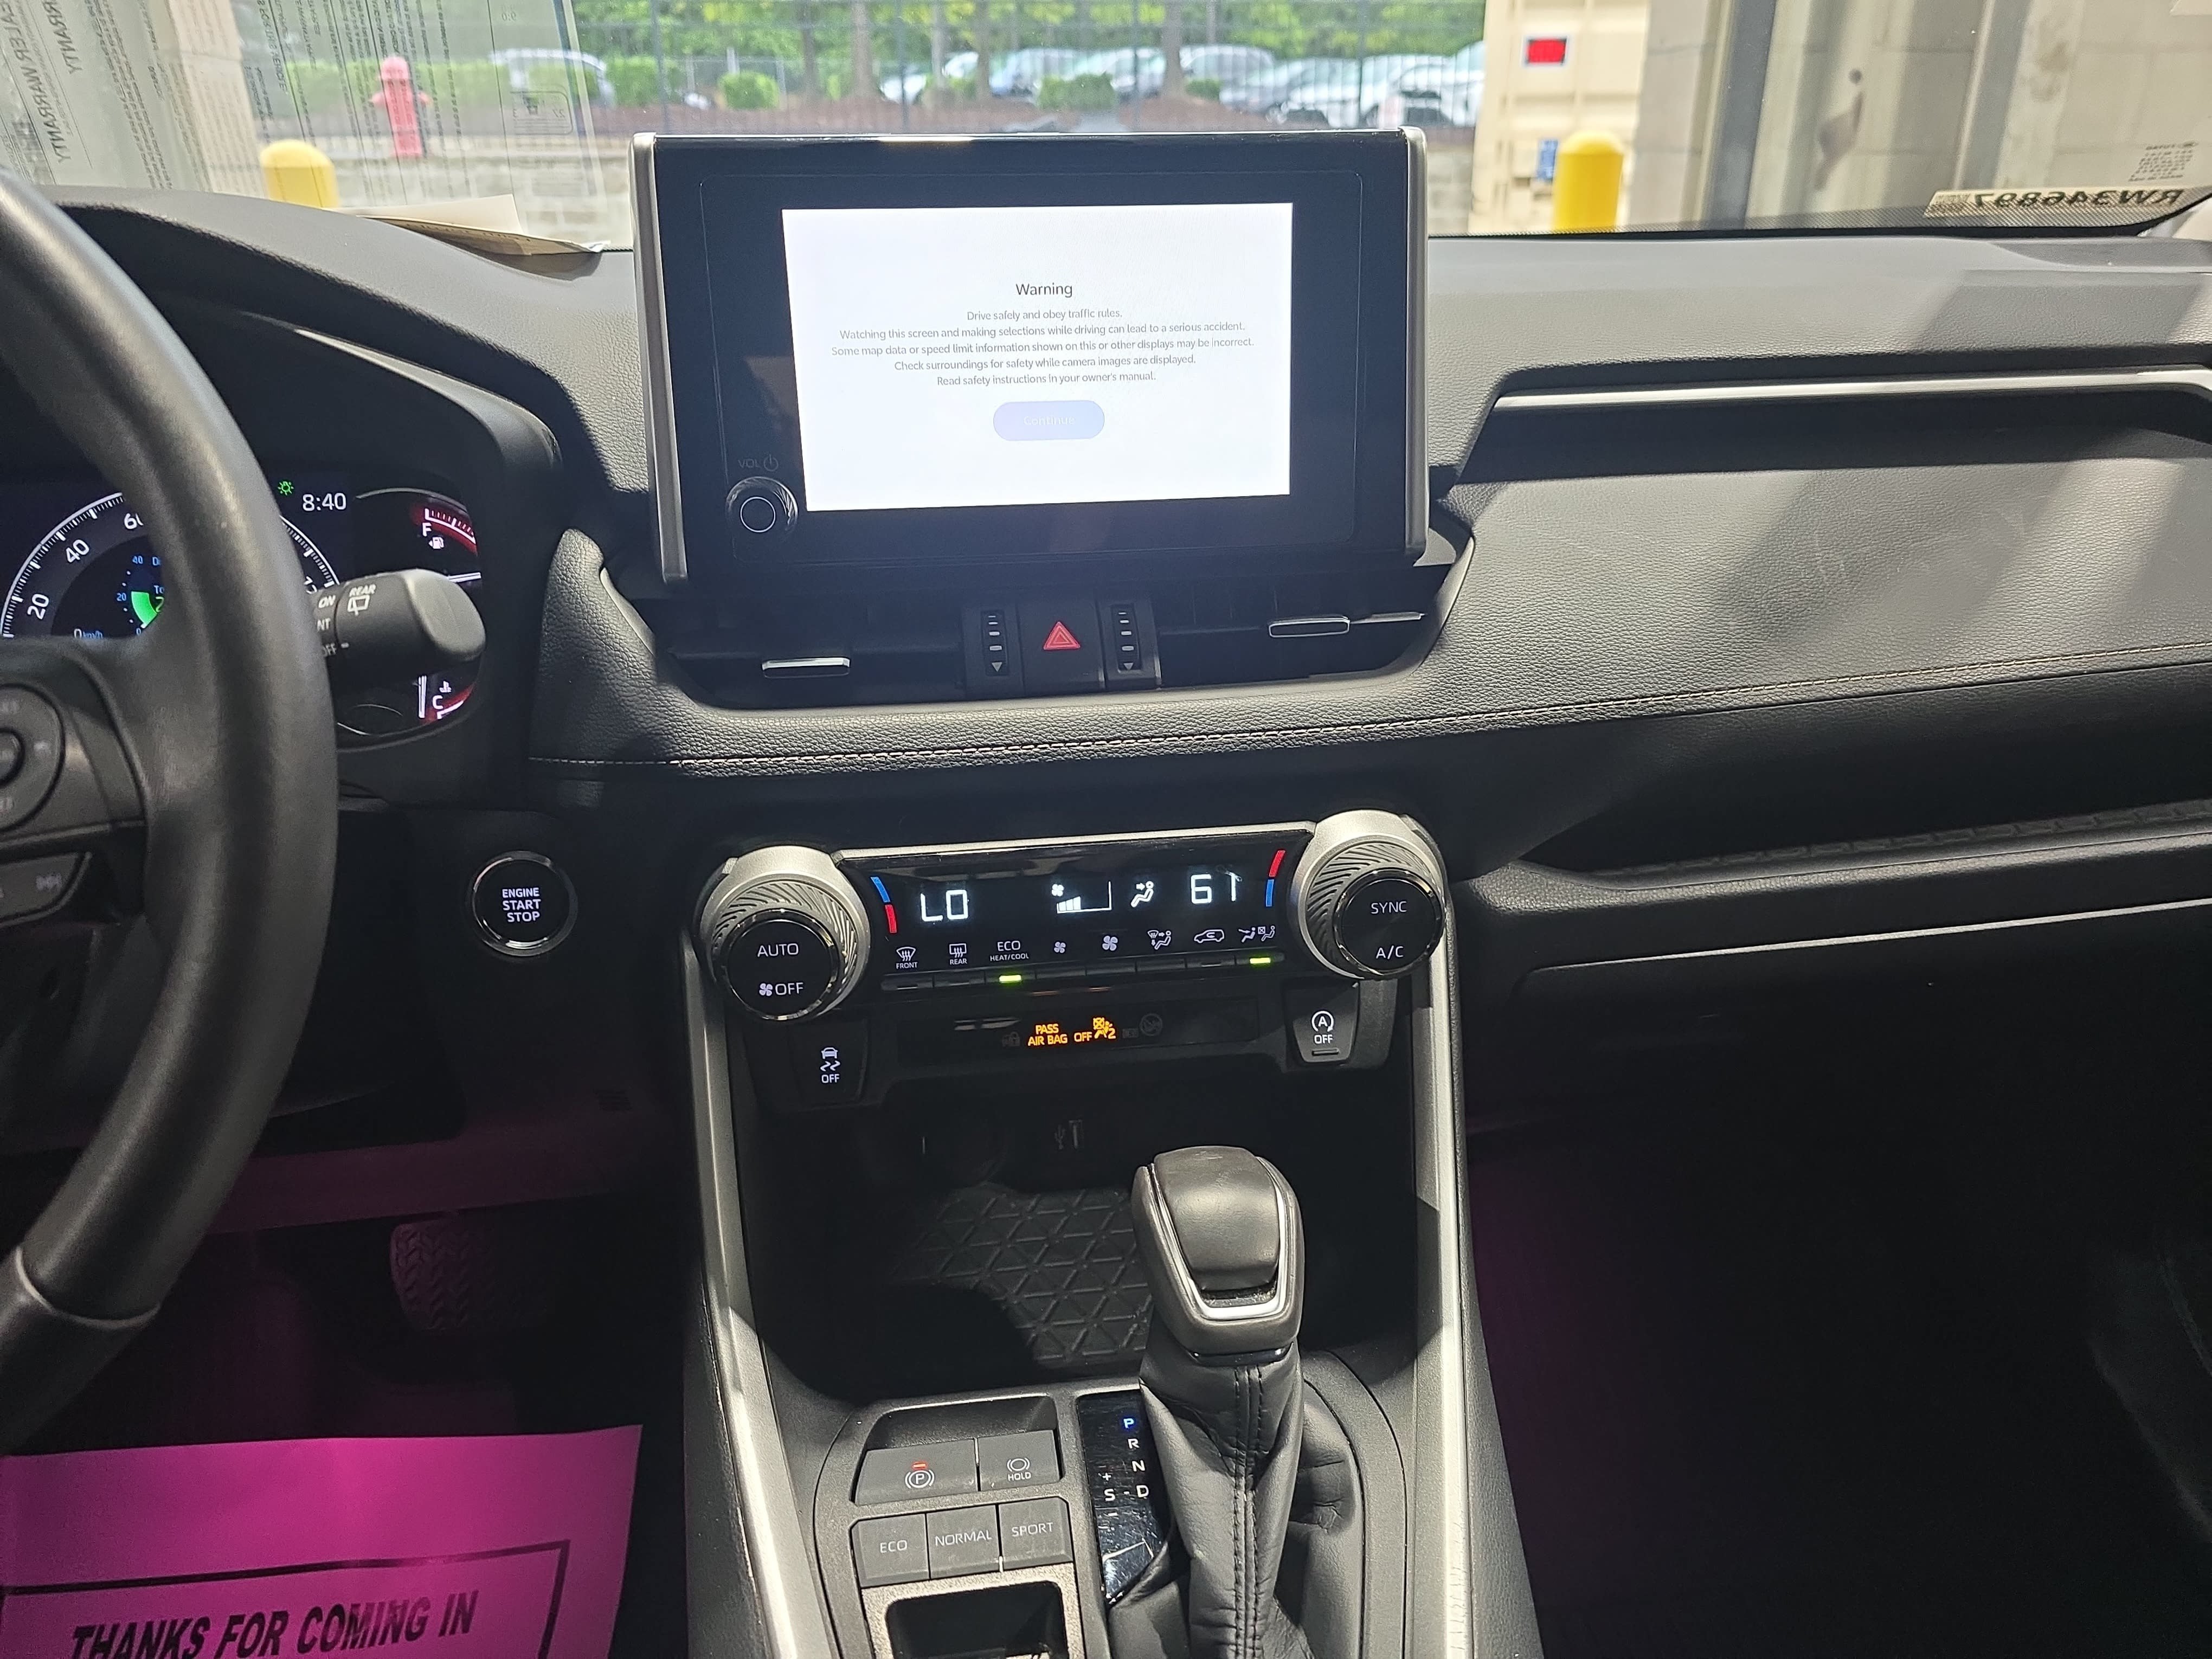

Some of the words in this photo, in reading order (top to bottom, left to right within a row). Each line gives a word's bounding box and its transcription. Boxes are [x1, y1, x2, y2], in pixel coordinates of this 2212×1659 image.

[1015, 282, 1072, 298] Warning
[968, 311, 991, 320] Drive
[994, 310, 1020, 321] safely
[1023, 310, 1040, 319] and
[1043, 309, 1065, 321] obey
[1069, 308, 1095, 318] traffic
[1098, 308, 1122, 318] rules.
[840, 330, 885, 340] Watching
[889, 329, 905, 338] this
[941, 327, 959, 337] and
[962, 327, 995, 338] making
[999, 326, 1045, 336] selections
[1047, 325, 1072, 335] while
[1075, 325, 1105, 336] driving
[1128, 324, 1146, 333] lead
[1150, 324, 1159, 332] to
[1169, 323, 1201, 332] serious
[1204, 321, 1245, 331] accident.
[832, 347, 859, 356] Some
[862, 348, 883, 357] map
[886, 345, 906, 354] data
[922, 344, 950, 356] speed
[953, 343, 973, 353] limit
[976, 343, 1030, 352] information
[1032, 342, 1063, 351] shown
[1080, 340, 1096, 350] this
[1111, 340, 1135, 350] other
[1137, 339, 1174, 351] displays
[1177, 340, 1195, 350] may
[1198, 338, 1209, 347] be
[1212, 337, 1253, 347] incorrect.
[895, 361, 924, 370] Check
[927, 360, 988, 371] surroundings
[991, 359, 1004, 368] for
[1006, 358, 1033, 370] safety
[1036, 357, 1060, 367] while
[1098, 356, 1130, 367] images
[1150, 354, 1195, 366] displayed.
[937, 376, 960, 385] Read
[963, 376, 990, 387] safety
[993, 374, 1046, 384] instructions
[1049, 374, 1057, 383] in
[1059, 375, 1080, 384] your
[1082, 373, 1116, 382] owner's
[1120, 371, 1156, 381] manual.
[738, 458, 762, 468] VOL
[302, 492, 346, 512] 8:40
[422, 523, 432, 537] F
[66, 539, 90, 564] 40
[132, 555, 144, 565] 40
[117, 592, 127, 602] 20
[349, 584, 376, 596] REAR
[26, 593, 50, 620] 20
[318, 594, 336, 609] ON
[317, 618, 331, 632] NT
[432, 695, 443, 709] C
[502, 887, 540, 899] ENGINE
[503, 899, 541, 911] START
[1371, 901, 1407, 914] SYNC
[507, 911, 541, 923] STOP
[757, 943, 800, 957] AUTO
[997, 940, 1021, 952] ECO
[1375, 944, 1404, 960] A/C
[989, 953, 1030, 962] HEAT/COOL
[896, 961, 918, 969] FRONT
[774, 982, 805, 996] OFF
[1035, 1023, 1059, 1035] PASS
[1027, 1035, 1045, 1046] AIR
[1047, 1033, 1068, 1045] BAG
[1073, 1031, 1093, 1043] OFF
[1314, 1033, 1333, 1045] OFF
[821, 1073, 840, 1084] OFF
[1123, 1418, 1134, 1429] P
[1128, 1438, 1140, 1450] R
[1132, 1459, 1146, 1472] N
[1007, 1471, 1032, 1482] HOLD
[1104, 1488, 1116, 1502] S
[1136, 1484, 1149, 1499] D
[1011, 1521, 1054, 1538] SPORT
[935, 1529, 992, 1547] NORMAL
[880, 1540, 908, 1554] ECO
[72, 1616, 211, 1659] THANKS
[214, 1610, 290, 1659] FOR
[297, 1596, 431, 1654] COMING
[438, 1590, 479, 1637] IN
